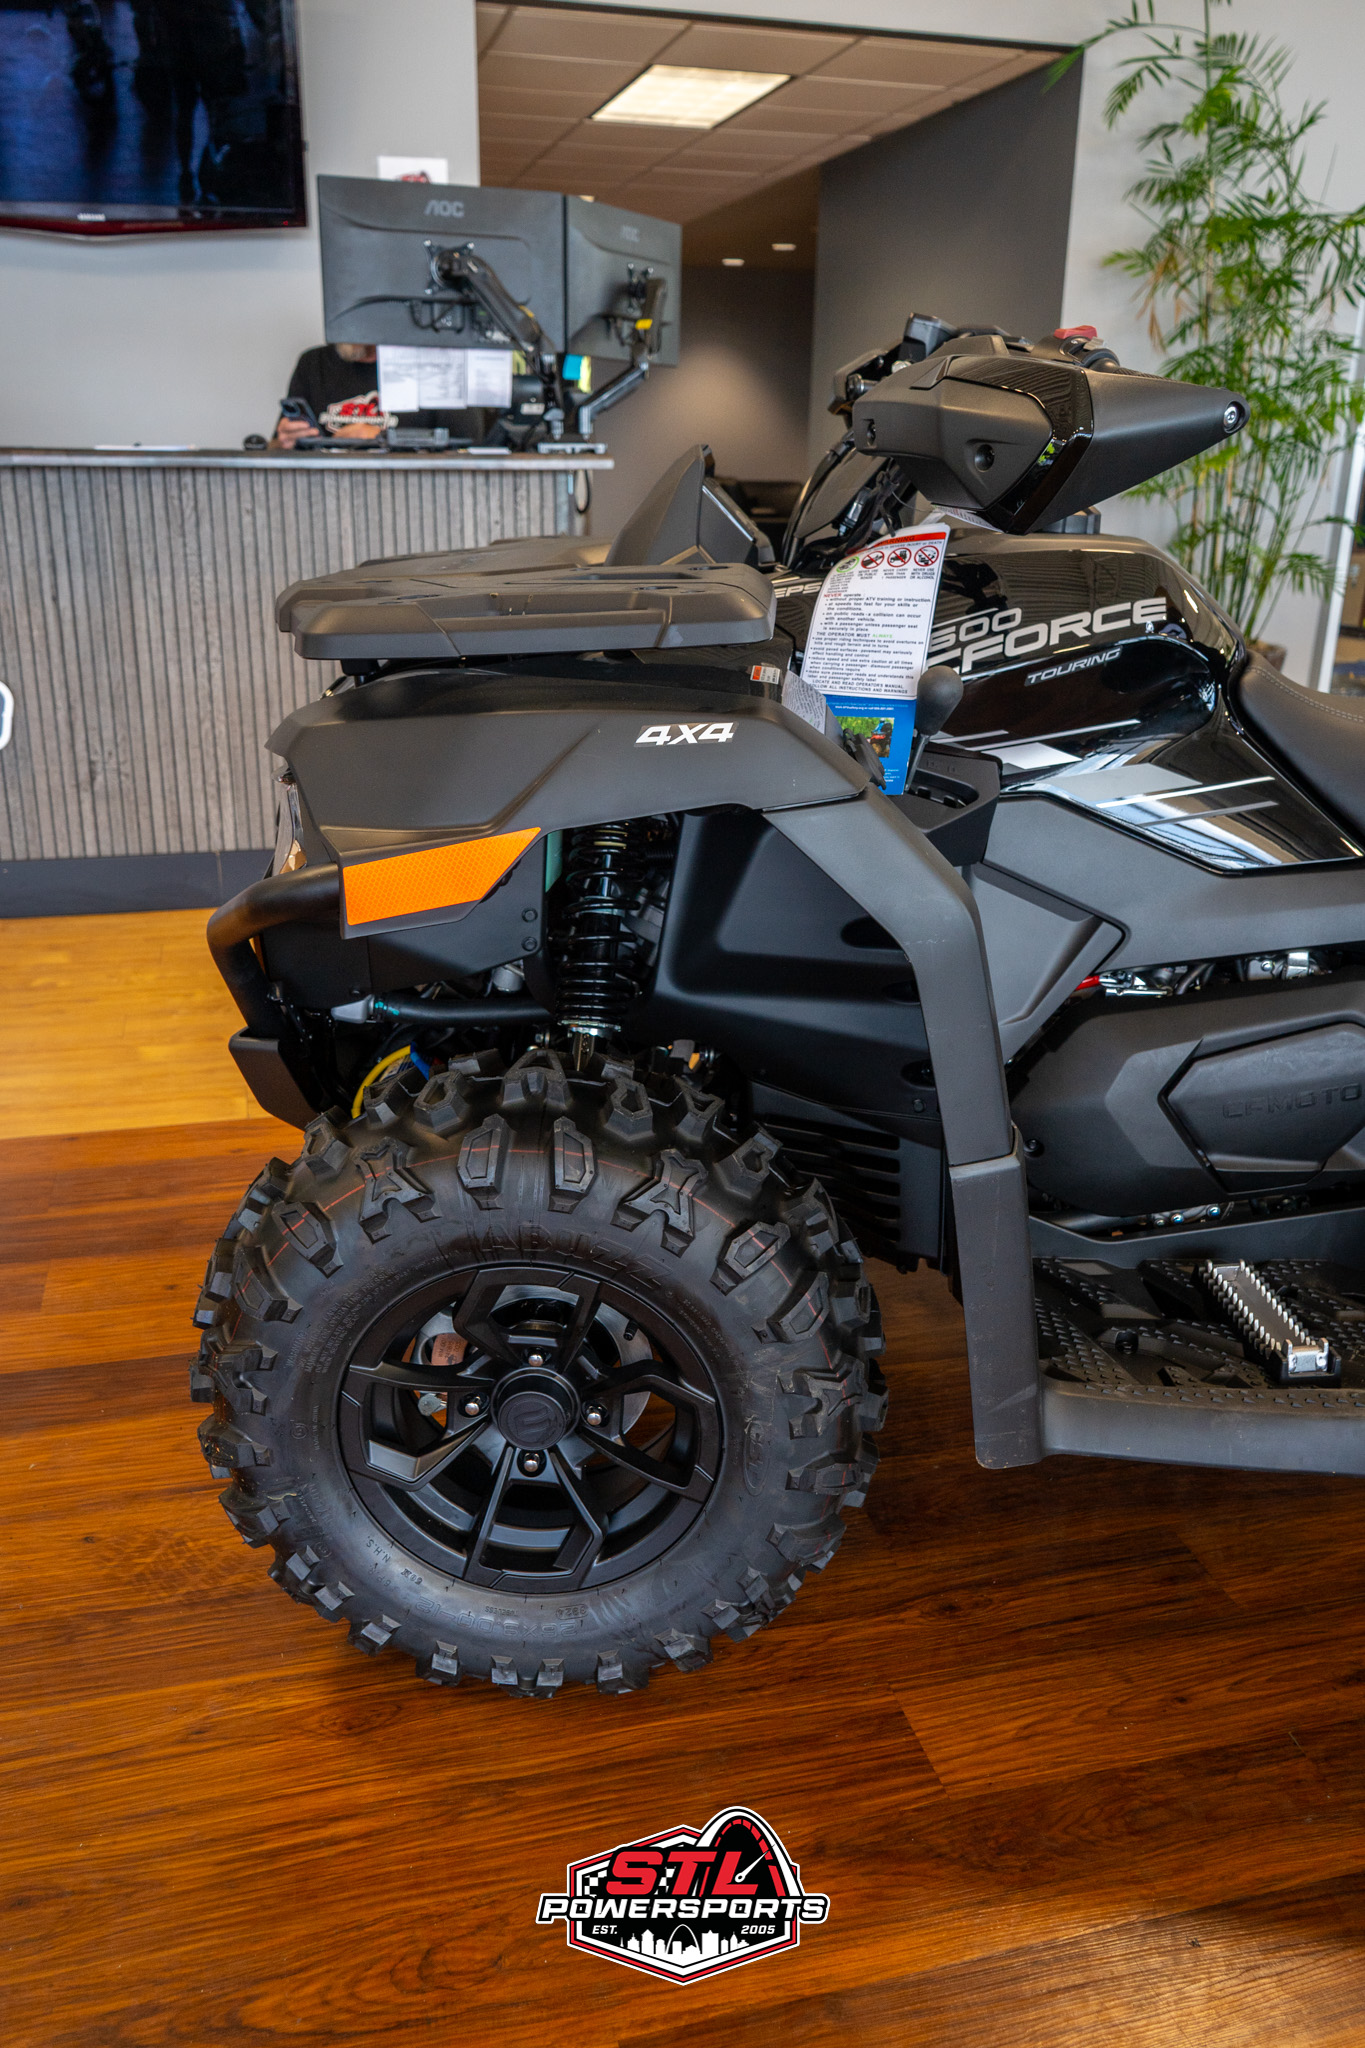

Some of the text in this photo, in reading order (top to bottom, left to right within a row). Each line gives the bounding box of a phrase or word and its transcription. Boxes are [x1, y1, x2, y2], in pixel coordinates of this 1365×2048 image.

[424, 200, 465, 218] AOC
[928, 607, 1022, 653] 500
[1027, 647, 1122, 684] TOURING
[635, 722, 734, 746] 4X4
[1222, 1083, 1361, 1119] CFMOTO
[366, 1536, 391, 1563] N.H.S.
